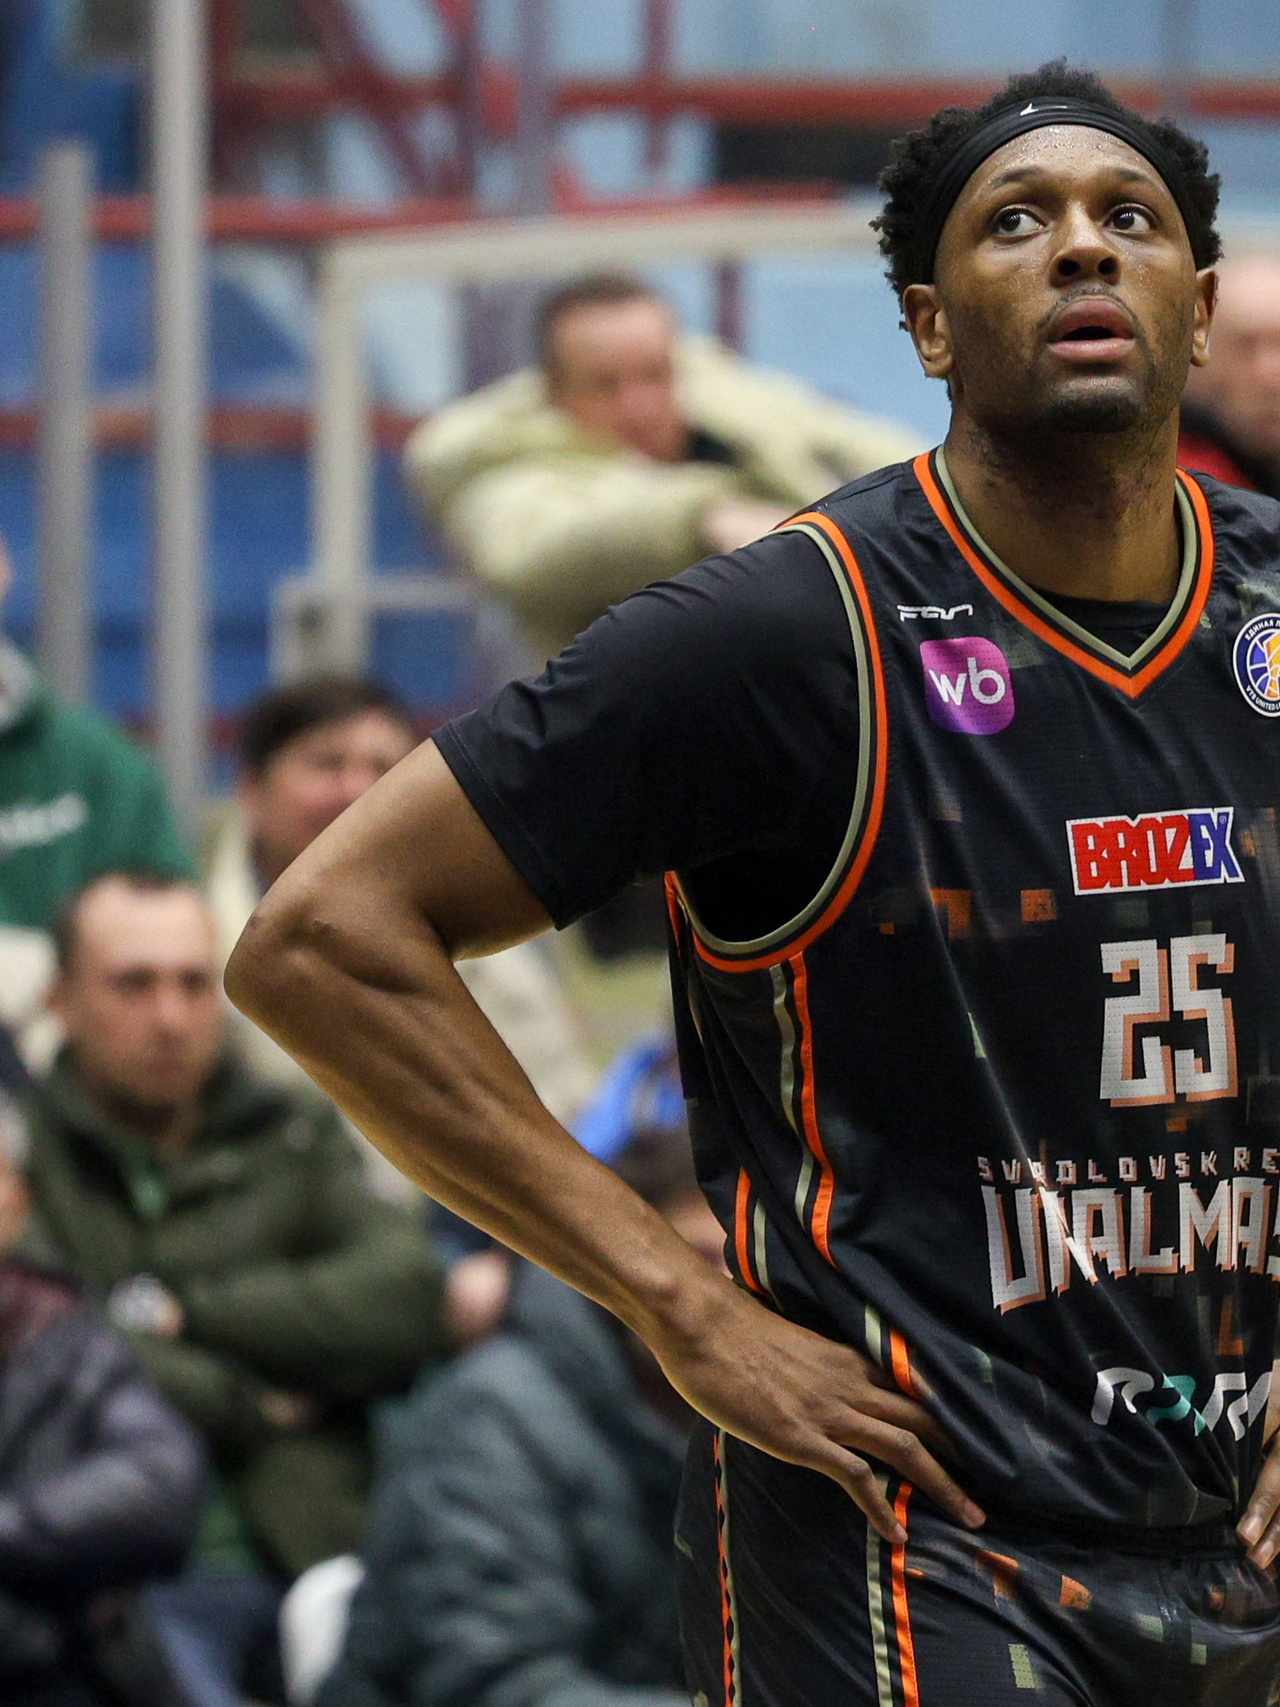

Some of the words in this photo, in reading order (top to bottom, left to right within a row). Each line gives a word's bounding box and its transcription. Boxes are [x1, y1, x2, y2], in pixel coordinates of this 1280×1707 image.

[1244, 619, 1274, 641] ЕДИНАЯ
[928, 657, 1006, 706] wb
[1245, 685, 1257, 701] VTB
[1255, 697, 1276, 711] UNITED
[1069, 809, 1242, 892] BROZEX
[1100, 933, 1238, 1107] 25
